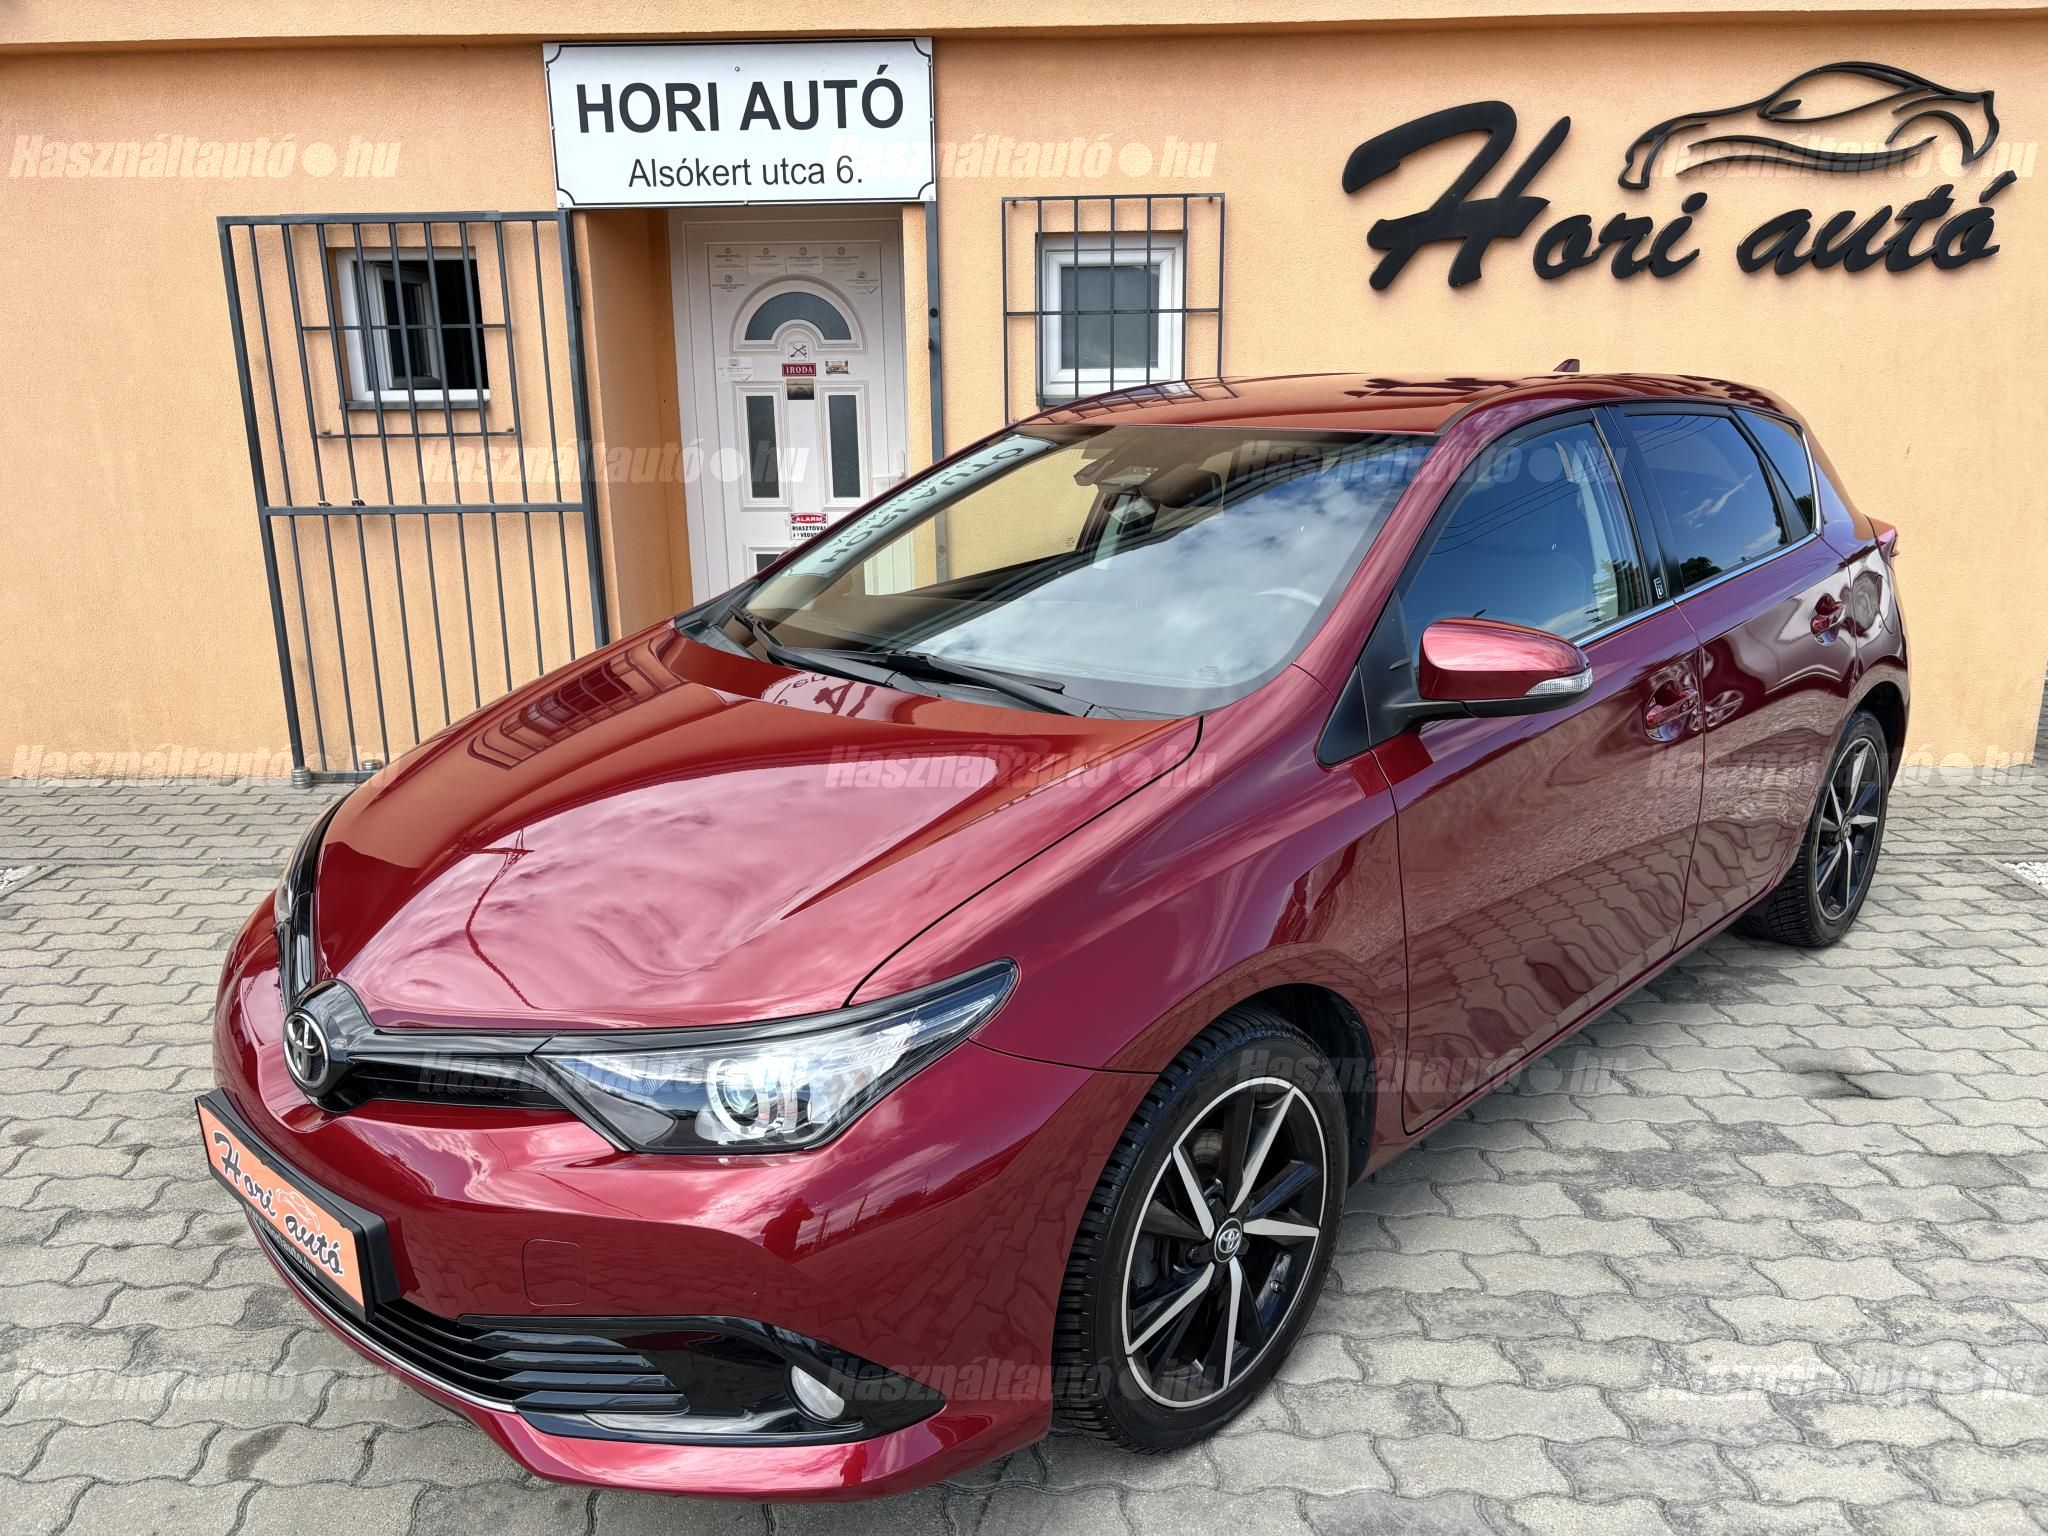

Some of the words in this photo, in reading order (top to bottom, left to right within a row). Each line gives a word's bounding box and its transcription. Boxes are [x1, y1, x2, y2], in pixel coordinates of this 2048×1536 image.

[576, 81, 720, 134] HORI
[739, 63, 904, 131] AUTÓ
[628, 157, 752, 188] Alsókert
[762, 160, 826, 186] utca
[835, 154, 863, 184] 6.
[1342, 100, 1707, 291] Hori
[1736, 169, 2018, 276] autó
[785, 366, 813, 374] IRODA
[213, 1131, 277, 1218] Hori
[284, 1214, 344, 1276] autó
